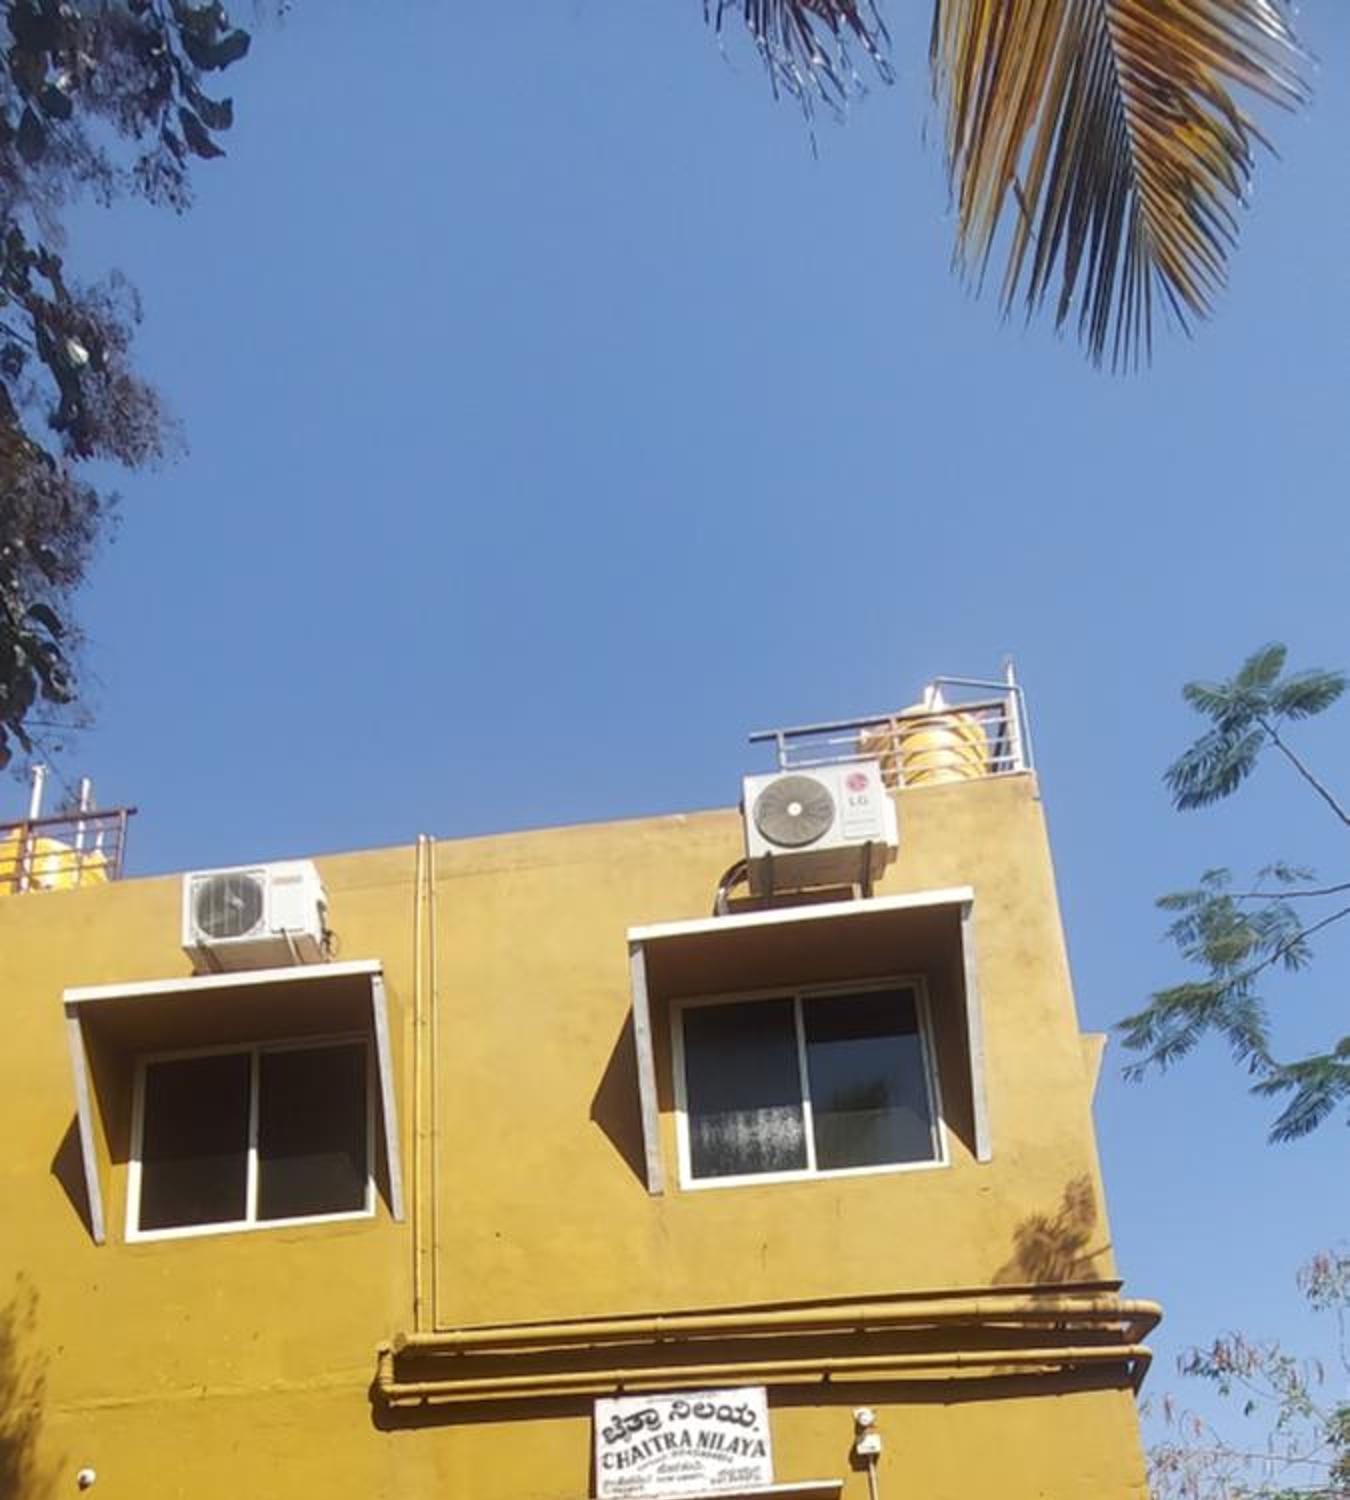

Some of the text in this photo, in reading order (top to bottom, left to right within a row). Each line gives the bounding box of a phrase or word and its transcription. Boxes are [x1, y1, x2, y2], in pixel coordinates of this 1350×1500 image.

[848, 795, 869, 807] LG
[602, 1429, 693, 1470] CHAITRA
[697, 1430, 766, 1458] NILAYA
